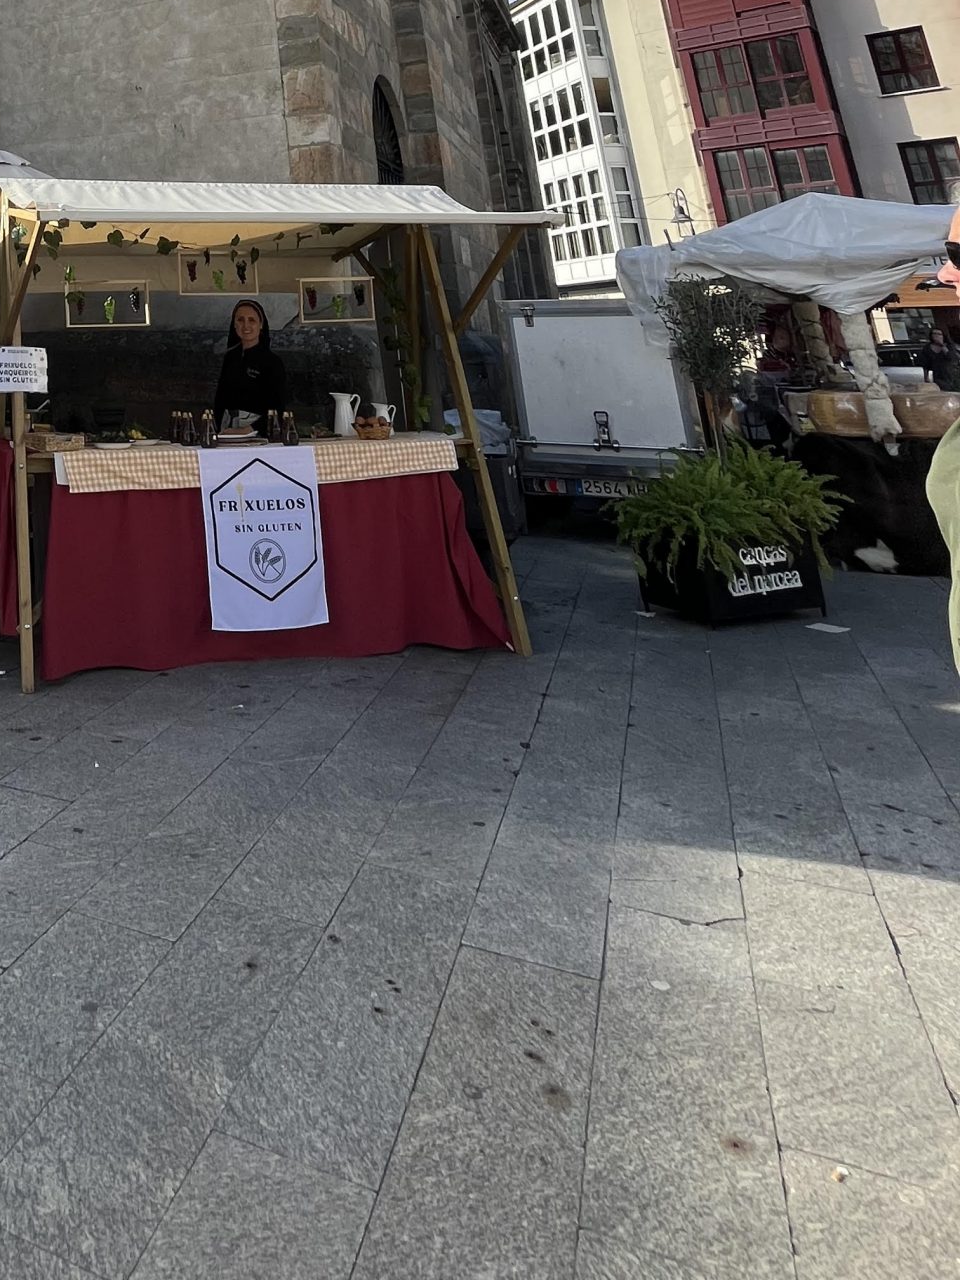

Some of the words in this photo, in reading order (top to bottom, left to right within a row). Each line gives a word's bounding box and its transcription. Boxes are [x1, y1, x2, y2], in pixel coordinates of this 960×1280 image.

[0, 369, 38, 377] VAQUEIROS
[12, 376, 38, 384] GLUTEN
[583, 480, 622, 496] 2564
[235, 523, 253, 533] SIN
[258, 522, 302, 533] GLUTEN
